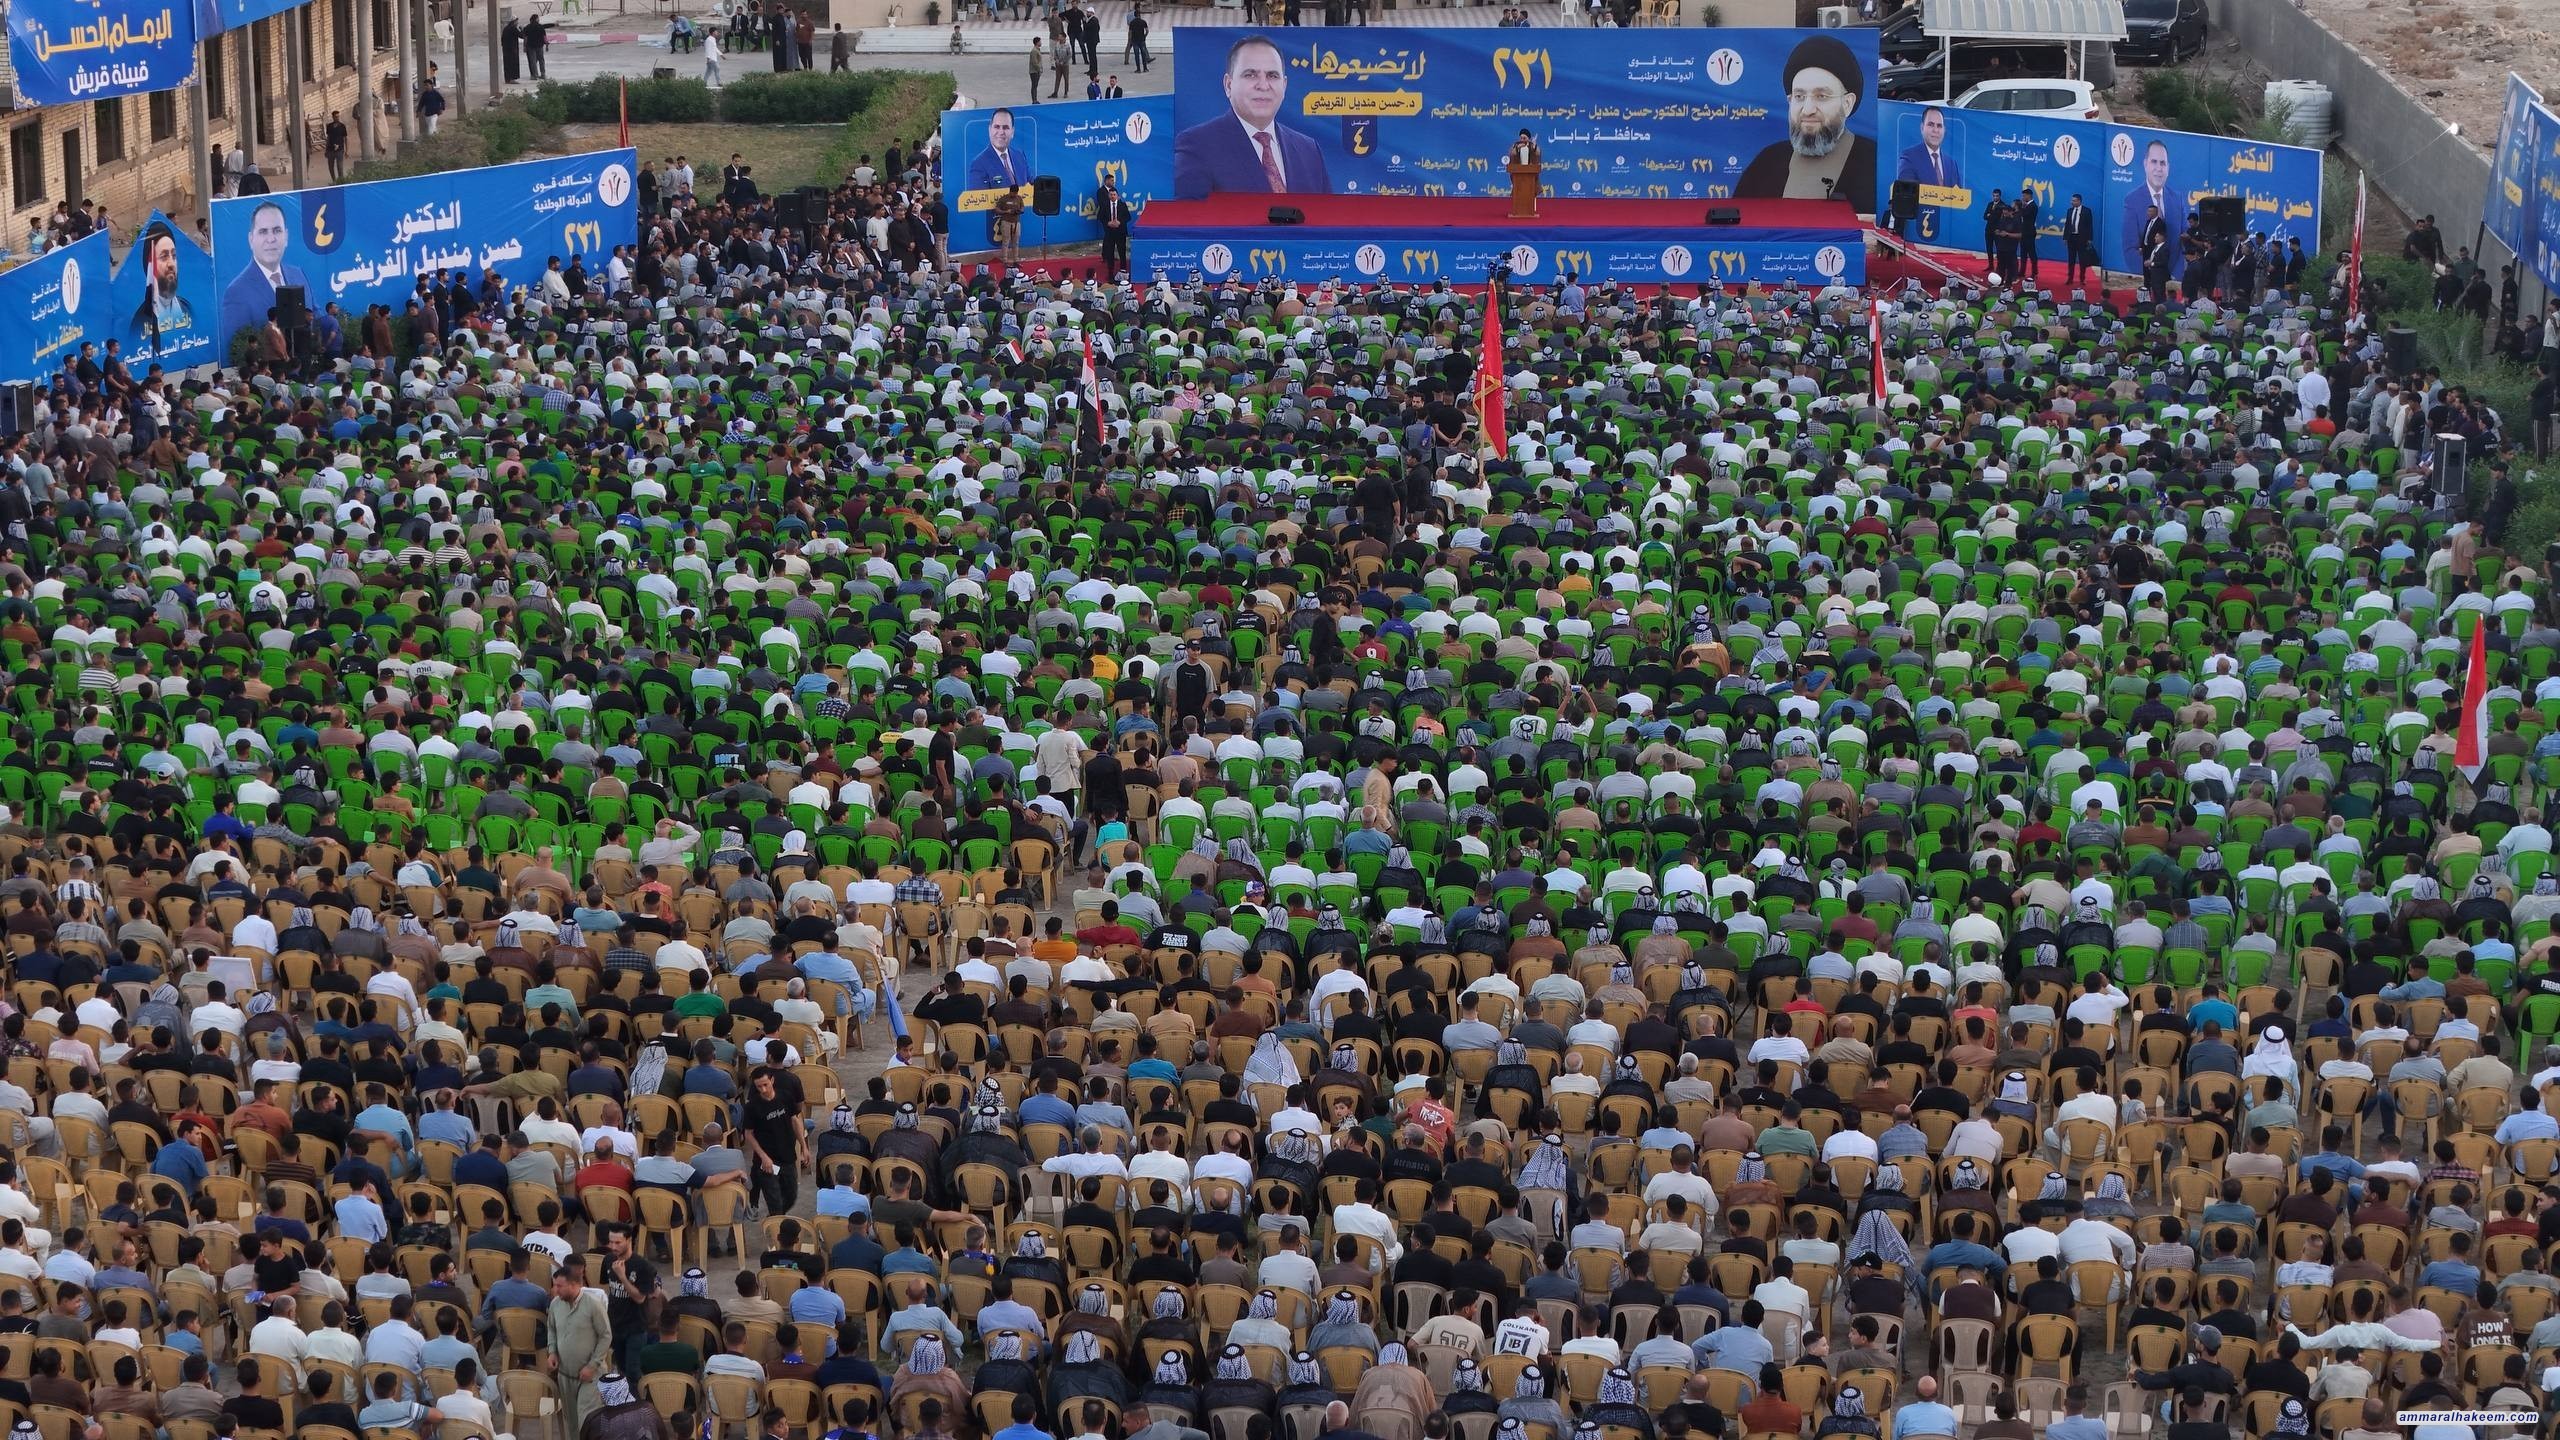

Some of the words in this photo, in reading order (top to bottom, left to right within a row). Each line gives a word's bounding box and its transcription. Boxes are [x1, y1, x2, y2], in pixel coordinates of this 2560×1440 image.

[1628, 56, 1657, 67] قوى
[1658, 56, 1694, 65] تحالف
[112, 60, 149, 88] قبيلة
[1493, 48, 1552, 89] ٢٣١
[69, 64, 110, 96] قريش
[1628, 71, 1662, 83] الوطنية
[1664, 71, 1694, 82] الدولة
[1310, 96, 1346, 113] القريشي
[1348, 96, 1377, 111] منديل
[1431, 103, 1468, 119] الحكيم
[1470, 103, 1499, 119] السيد
[1502, 103, 1543, 119] بسماحة
[1546, 104, 1577, 119] ترحب
[1589, 104, 1620, 119] منديل
[1622, 106, 1652, 120] حسن
[1653, 104, 1688, 119] الدكتور
[1691, 104, 1728, 121] المرشح
[1730, 104, 1768, 120] جماهير
[1065, 121, 1088, 134] قوى
[1090, 118, 1120, 128] تحالف
[1064, 136, 1093, 148] الوطنية
[1094, 134, 1120, 146] الدولة
[1353, 126, 1370, 155] ٤
[1548, 127, 1590, 144] بابل
[1593, 127, 1651, 143] محافظة
[1992, 134, 2016, 144] قوى
[2018, 137, 2048, 147] تحالف
[1992, 148, 2021, 161] الوطنية
[2022, 151, 2048, 163] الدولة
[2228, 148, 2273, 173] الدكتور
[532, 177, 556, 193] قوى
[557, 173, 592, 188] تحالف
[533, 196, 566, 212] الوطنية
[567, 192, 592, 207] الدولة
[2244, 187, 2278, 214] منديل
[2283, 197, 2314, 220] حسن
[314, 203, 334, 247] ٤
[392, 200, 462, 243] الدكتور
[564, 220, 601, 255] ٢٣١
[413, 243, 473, 278] منديل
[479, 236, 523, 270] حسن
[1150, 251, 1170, 260] قوى
[1171, 251, 1197, 259] تحالف
[1303, 251, 1325, 260] قوى
[1325, 251, 1350, 259] تحالف
[1609, 252, 1630, 261] قوى
[1631, 252, 1656, 260] تحالف
[1762, 253, 1784, 262] قوى
[1785, 252, 1810, 261] تحالف
[1249, 249, 1286, 275] ٢٣١
[1303, 262, 1330, 271] الوطنية
[1330, 262, 1350, 270] الدولة
[1402, 249, 1440, 276] ٢٣١
[1609, 263, 1634, 272] الوطنية
[1635, 263, 1656, 271] الدولة
[1762, 263, 1789, 272] الوطنية
[1790, 263, 1810, 271] الدولة
[330, 247, 408, 298] القريشي
[181, 333, 210, 350] سماحة
[1502, 1322, 1538, 1334] COLTRANE
